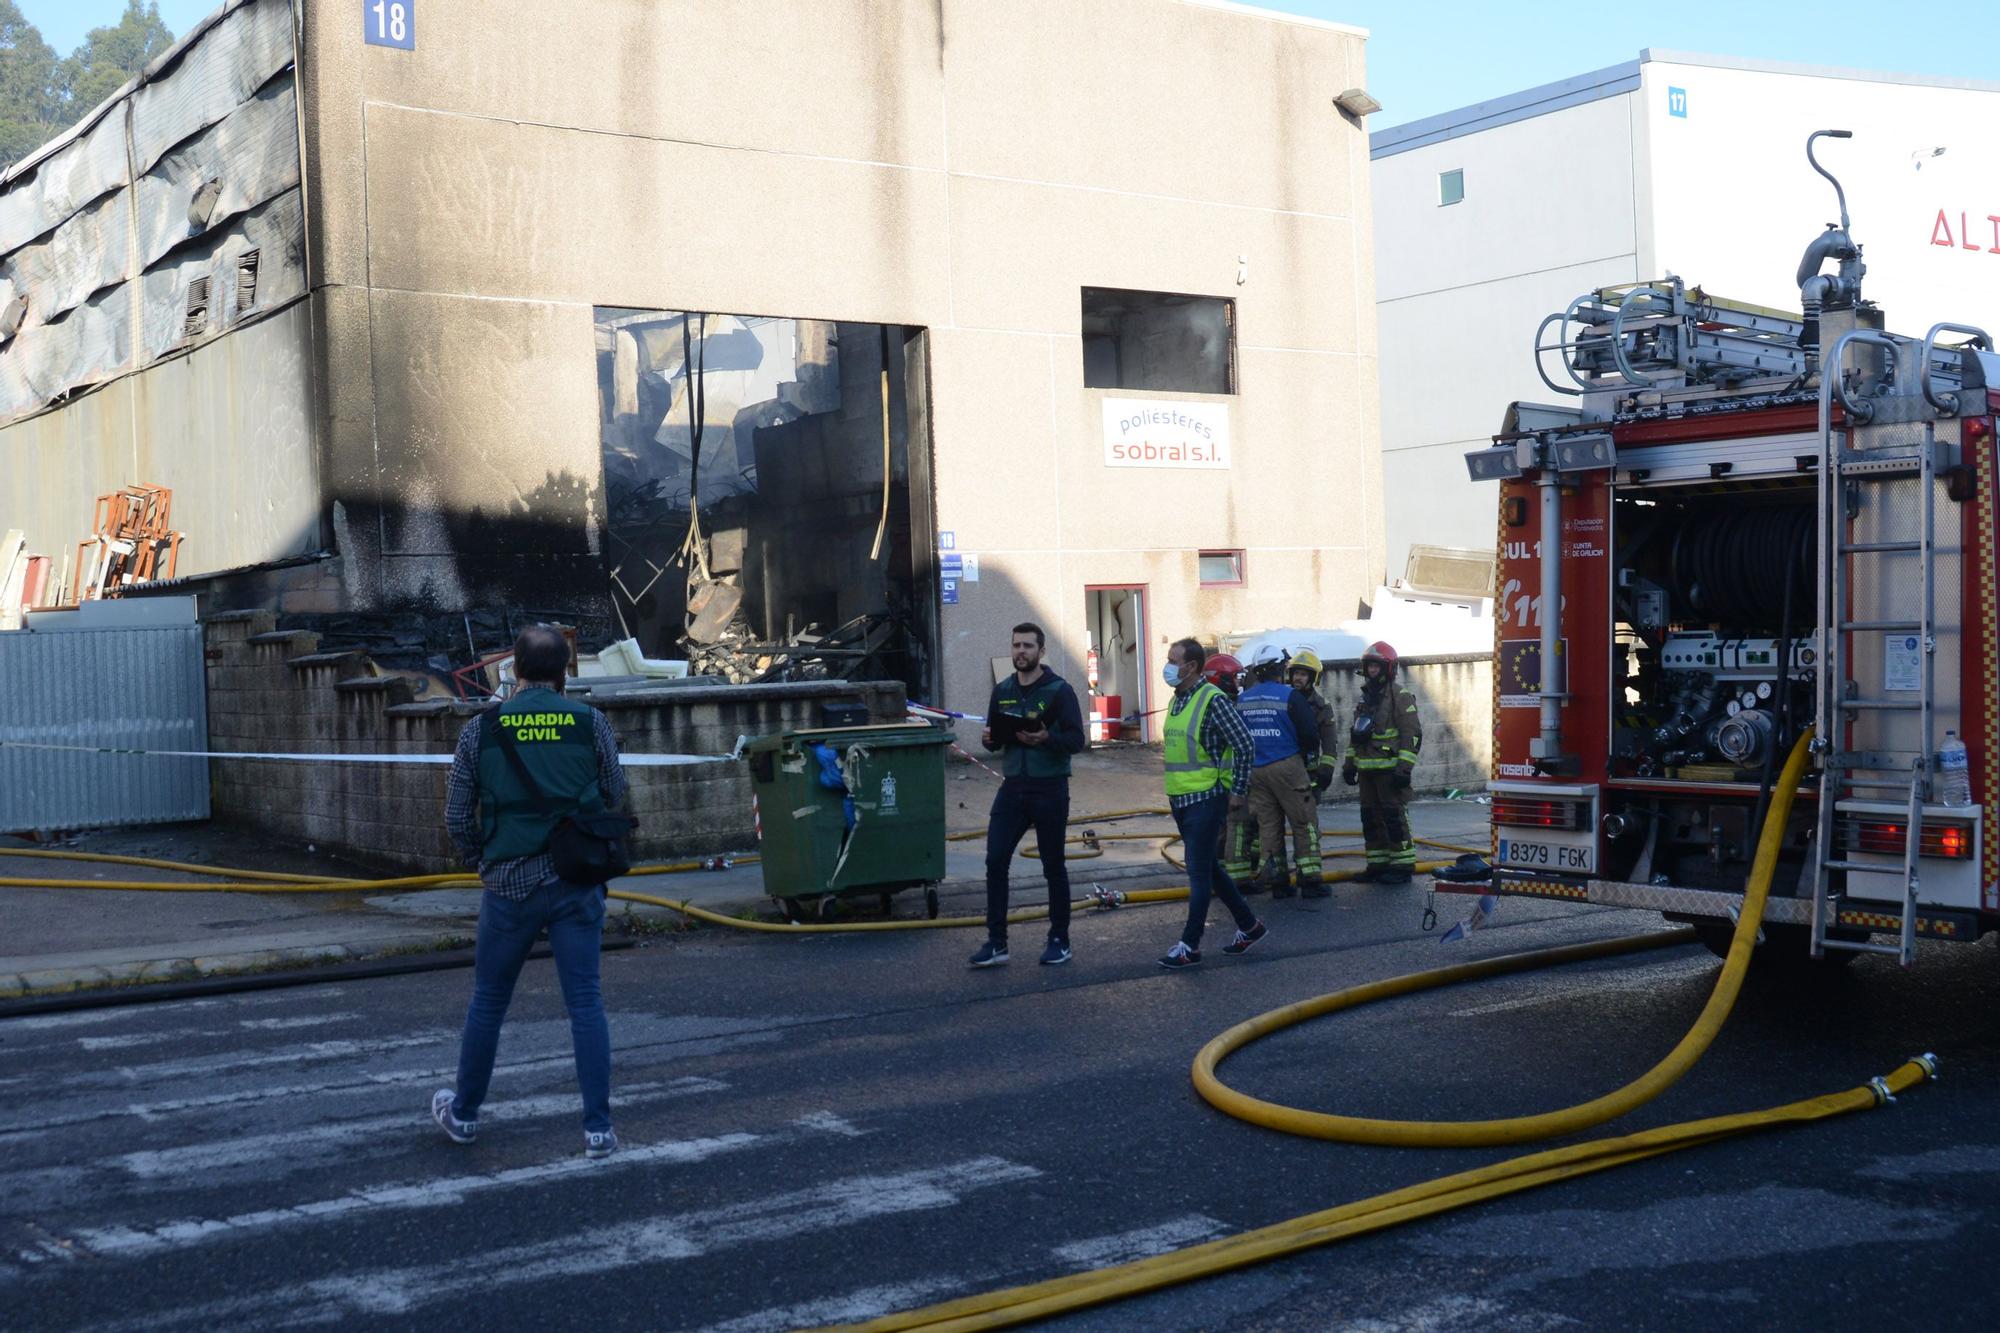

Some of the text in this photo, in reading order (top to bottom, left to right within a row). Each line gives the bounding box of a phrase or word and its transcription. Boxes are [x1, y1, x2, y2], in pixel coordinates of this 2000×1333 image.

[373, 0, 406, 41] 18
[1671, 92, 1685, 112] 17
[1113, 440, 1221, 461] sobral s.l.
[941, 532, 954, 548] 18
[499, 713, 576, 727] GUARDIA
[516, 728, 561, 741] CIVIL
[1510, 842, 1587, 868] 8379 FGK
